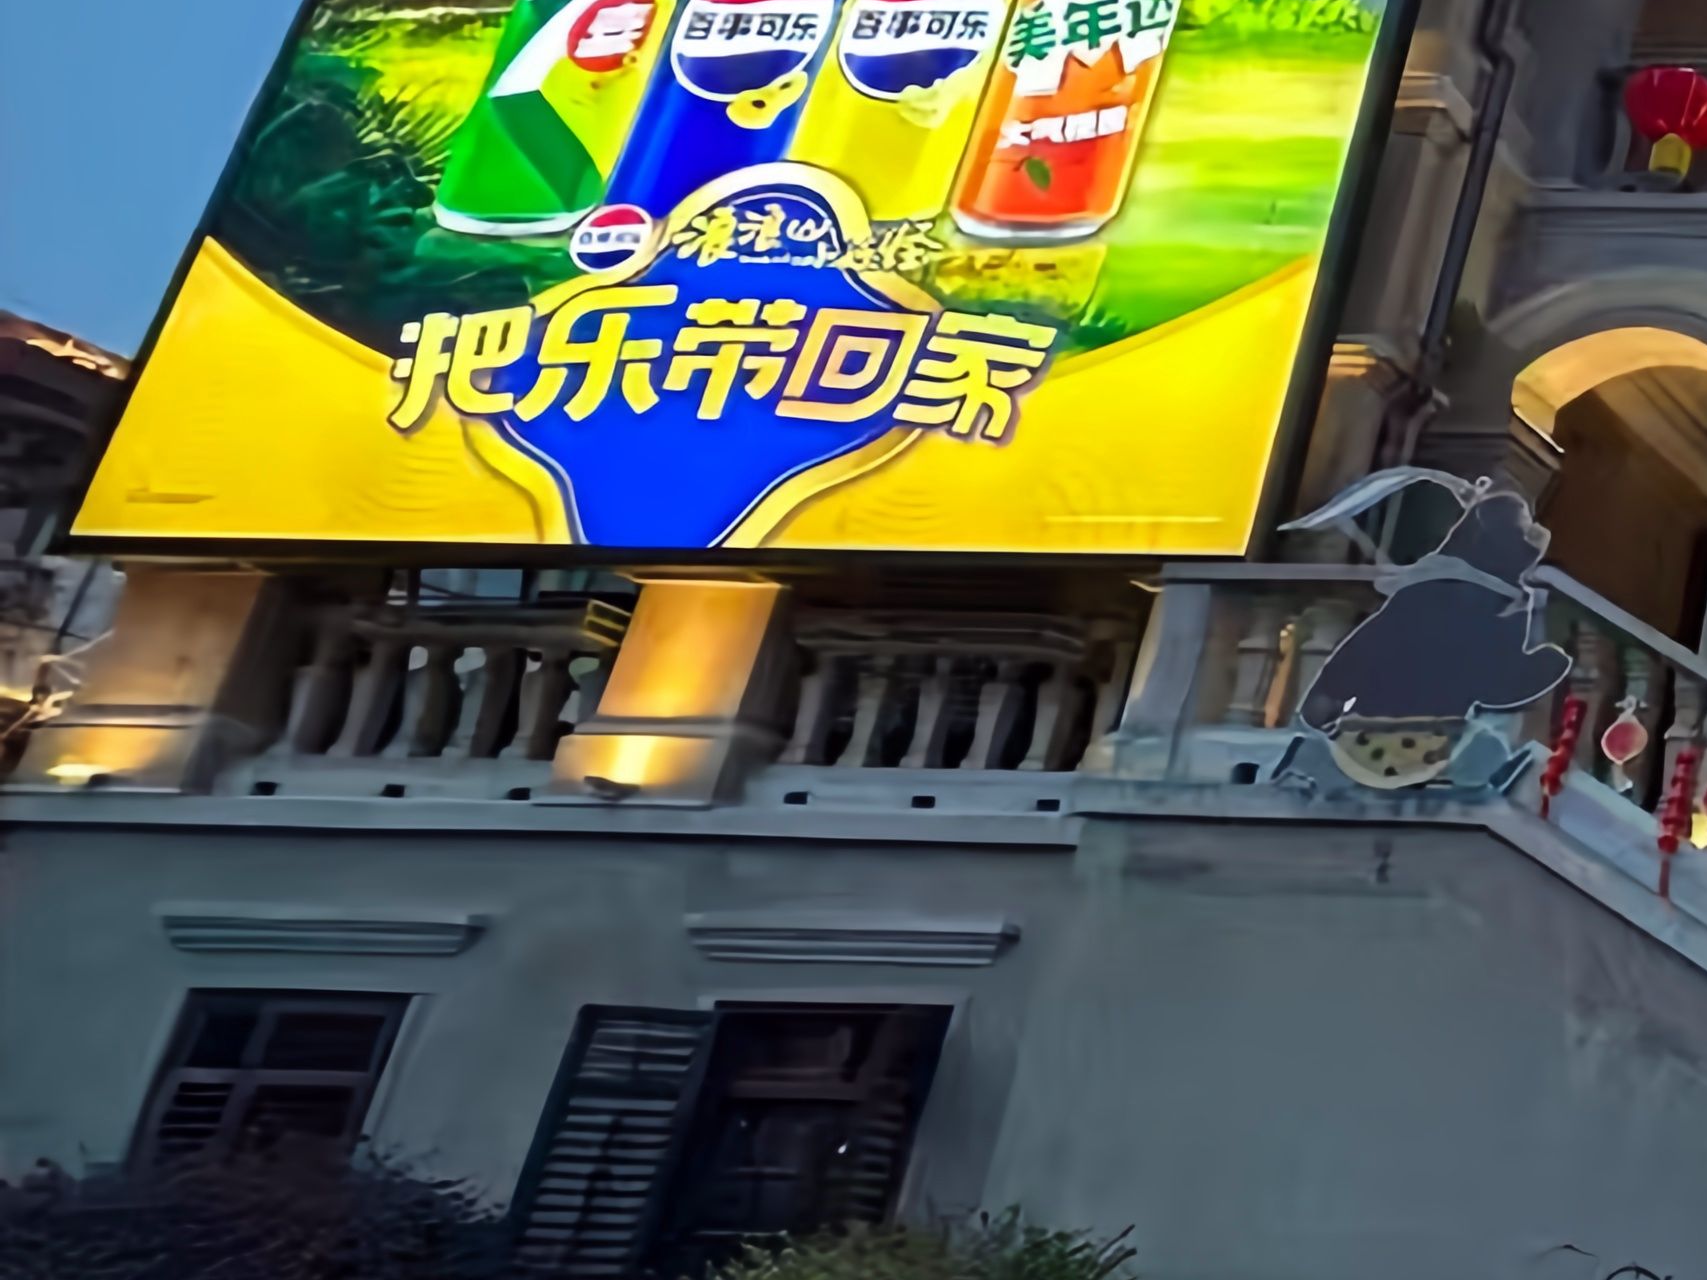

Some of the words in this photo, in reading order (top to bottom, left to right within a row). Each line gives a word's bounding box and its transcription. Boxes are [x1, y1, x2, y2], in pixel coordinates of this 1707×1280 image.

[387, 284, 1057, 439] 把乐带回家
